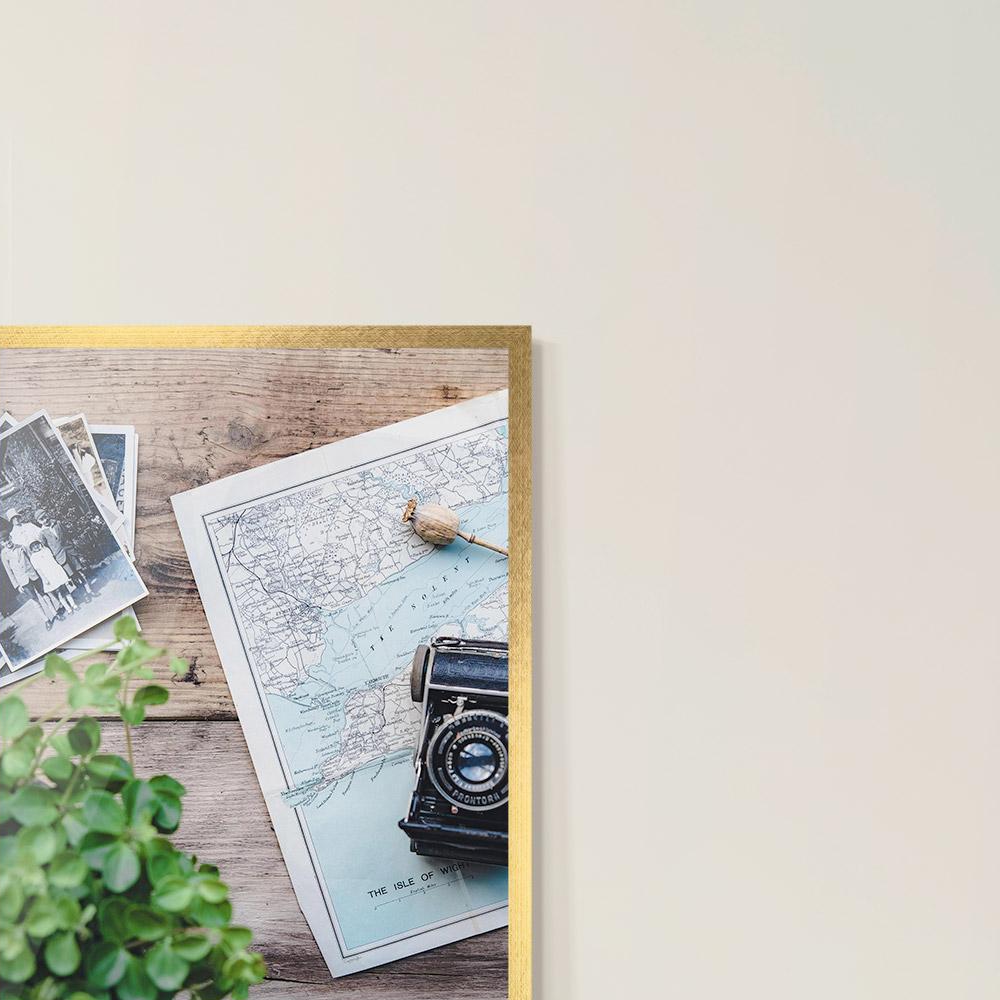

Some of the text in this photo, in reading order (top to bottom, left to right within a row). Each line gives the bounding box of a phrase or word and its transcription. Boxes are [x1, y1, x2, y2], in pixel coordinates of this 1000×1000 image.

[367, 886, 388, 898] THE
[393, 877, 415, 891] ISLE
[420, 871, 434, 882] OF
